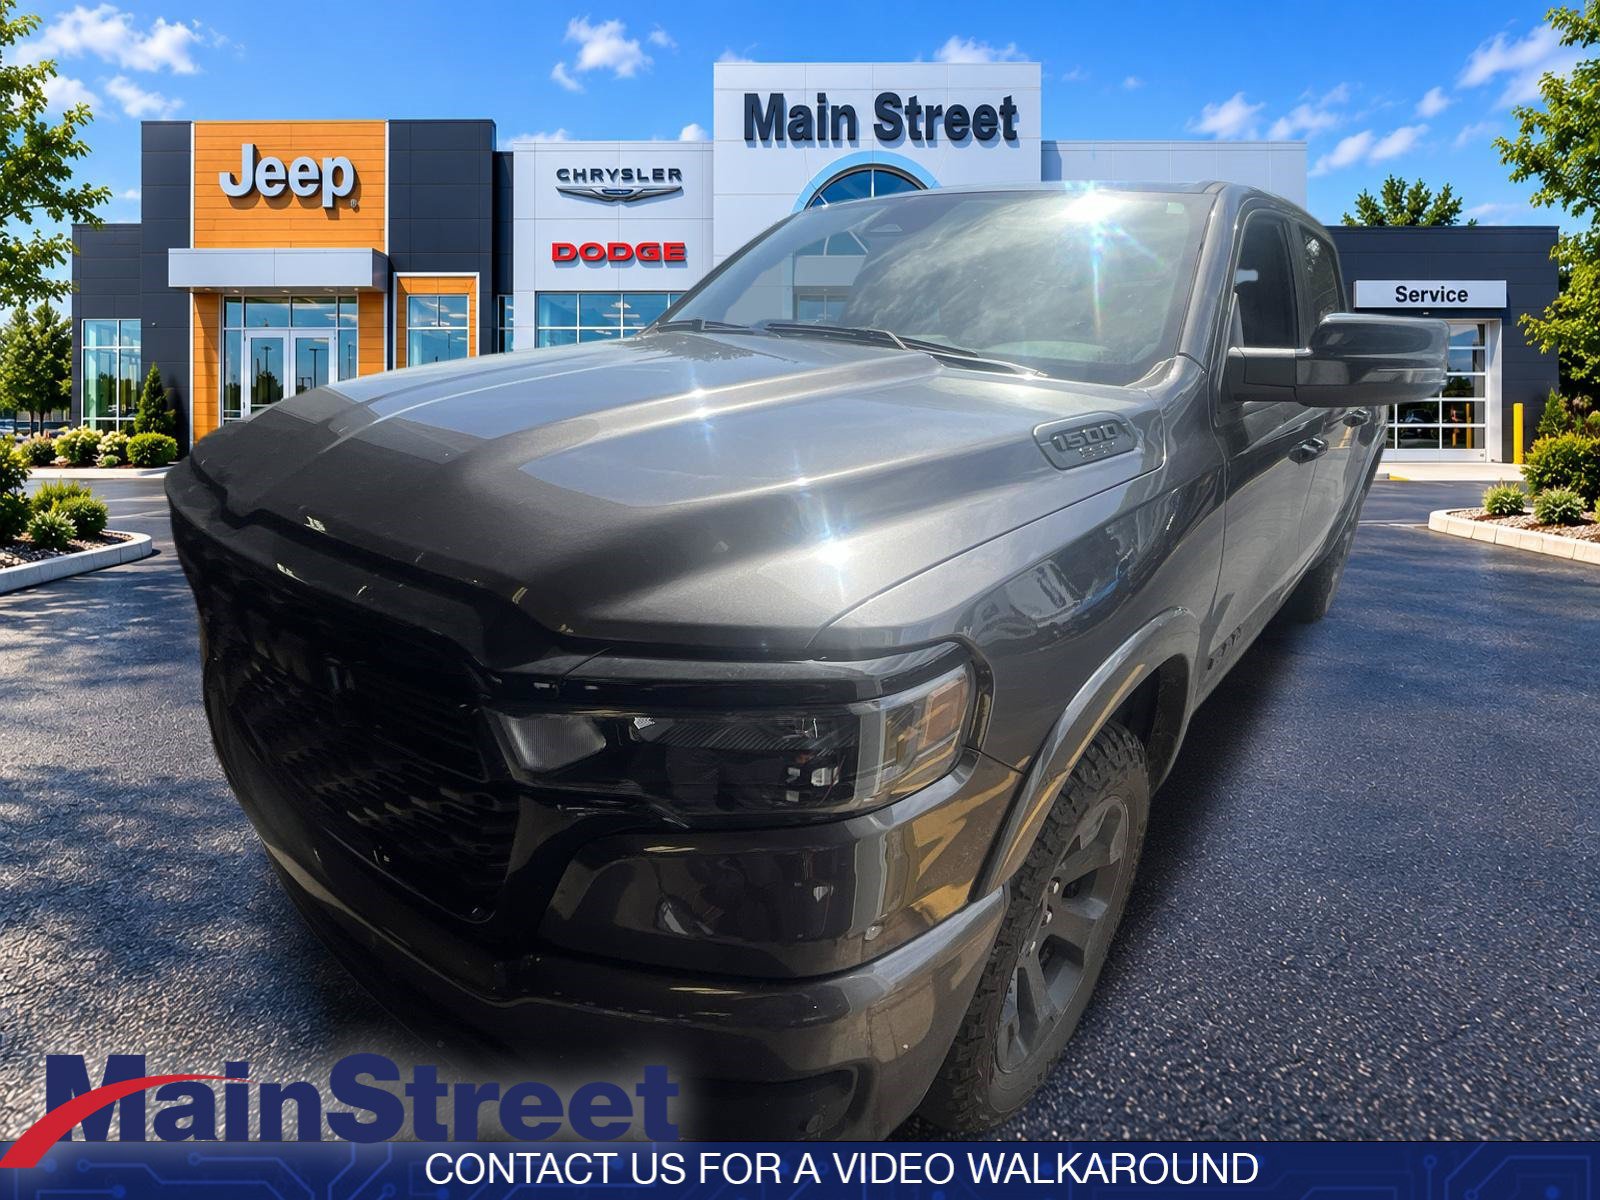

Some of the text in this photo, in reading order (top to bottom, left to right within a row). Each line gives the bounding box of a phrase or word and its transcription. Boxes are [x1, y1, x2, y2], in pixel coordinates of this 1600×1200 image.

[744, 92, 1018, 141] Main Street
[219, 143, 355, 208] Jeep
[556, 168, 682, 181] CHRYSLER
[551, 242, 686, 262] DODGE
[1395, 285, 1469, 303] Service
[1053, 422, 1119, 451] 1500
